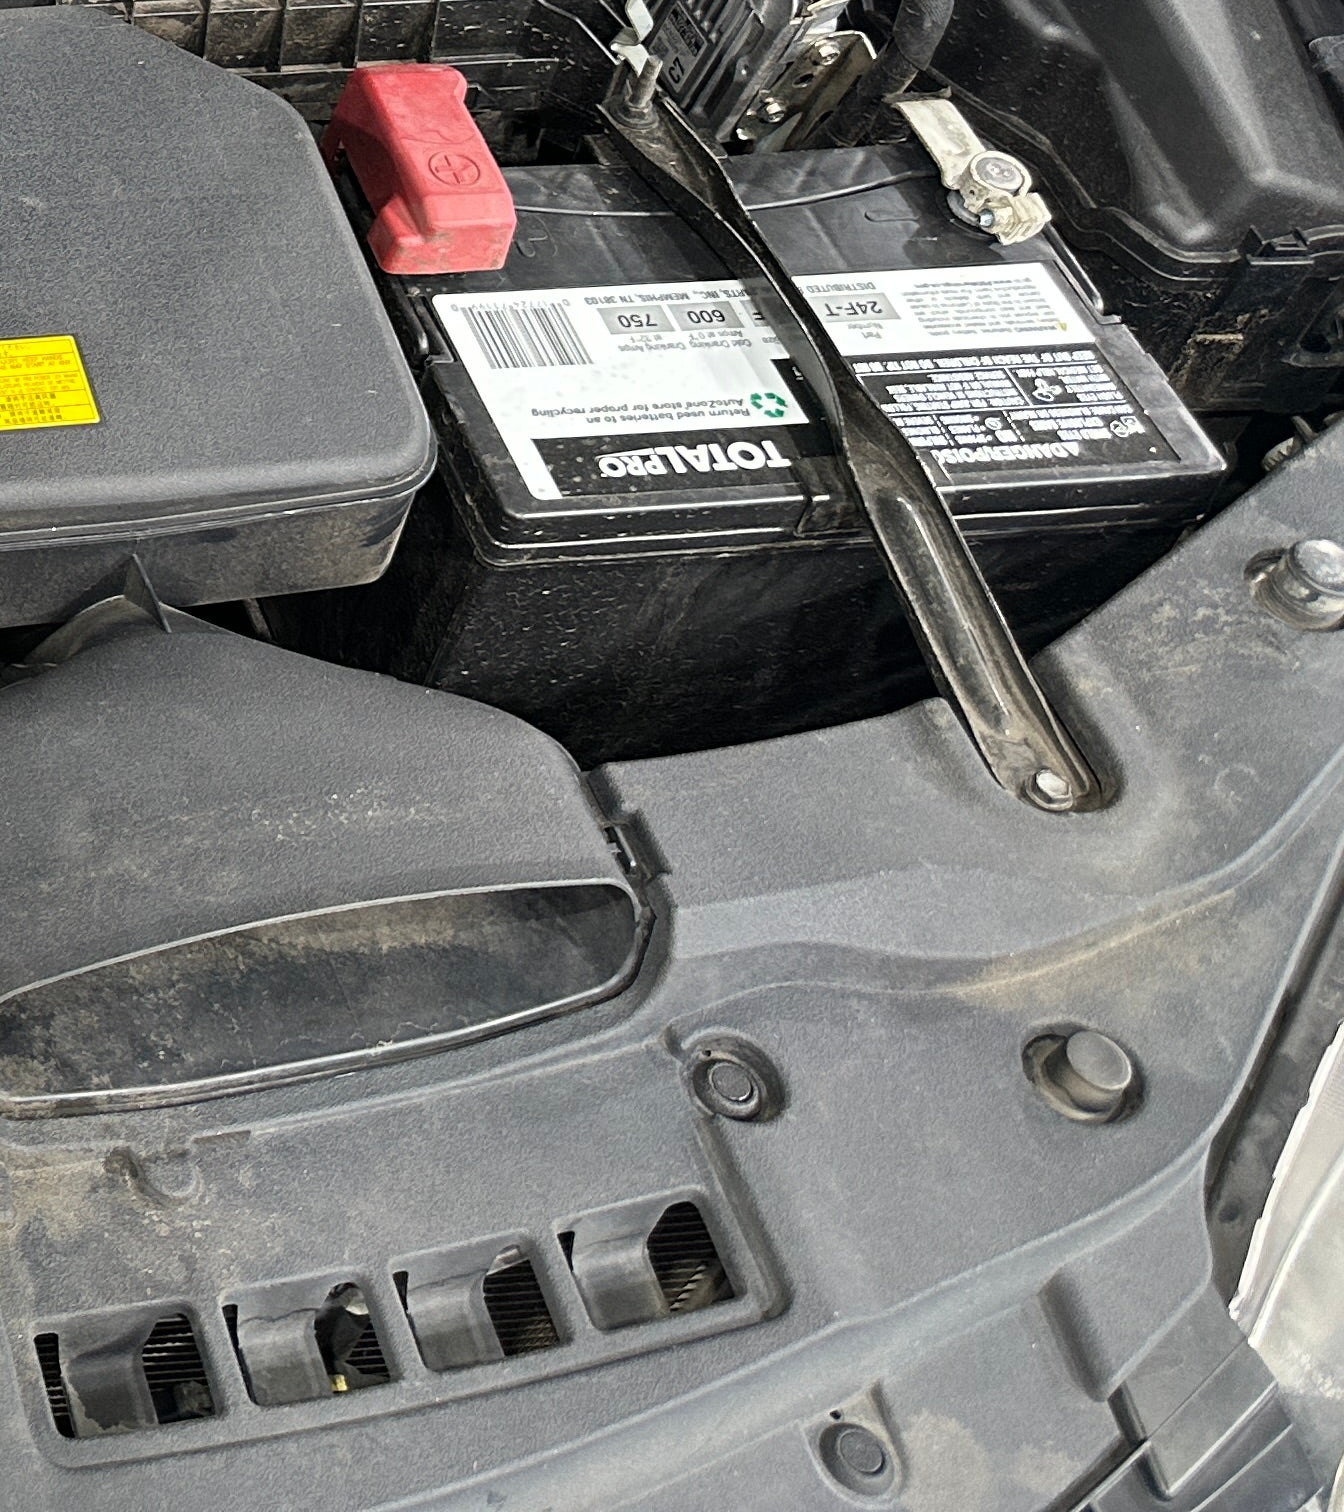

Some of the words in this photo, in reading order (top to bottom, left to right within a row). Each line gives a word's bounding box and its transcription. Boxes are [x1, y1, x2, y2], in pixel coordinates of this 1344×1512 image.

[668, 57, 687, 84] C7
[824, 301, 884, 317] 24F-T
[617, 313, 658, 328] 750
[686, 309, 726, 324] 600
[590, 404, 629, 415] proper
[632, 403, 649, 413] for
[652, 401, 682, 411] store
[531, 407, 586, 418] recycling
[620, 412, 673, 423] batteries
[677, 410, 705, 420] used
[709, 408, 750, 418] Return
[586, 416, 601, 424] an
[604, 415, 617, 424] to
[930, 442, 1070, 464] DANGER/POIS
[601, 440, 792, 478] TOTALPRO
